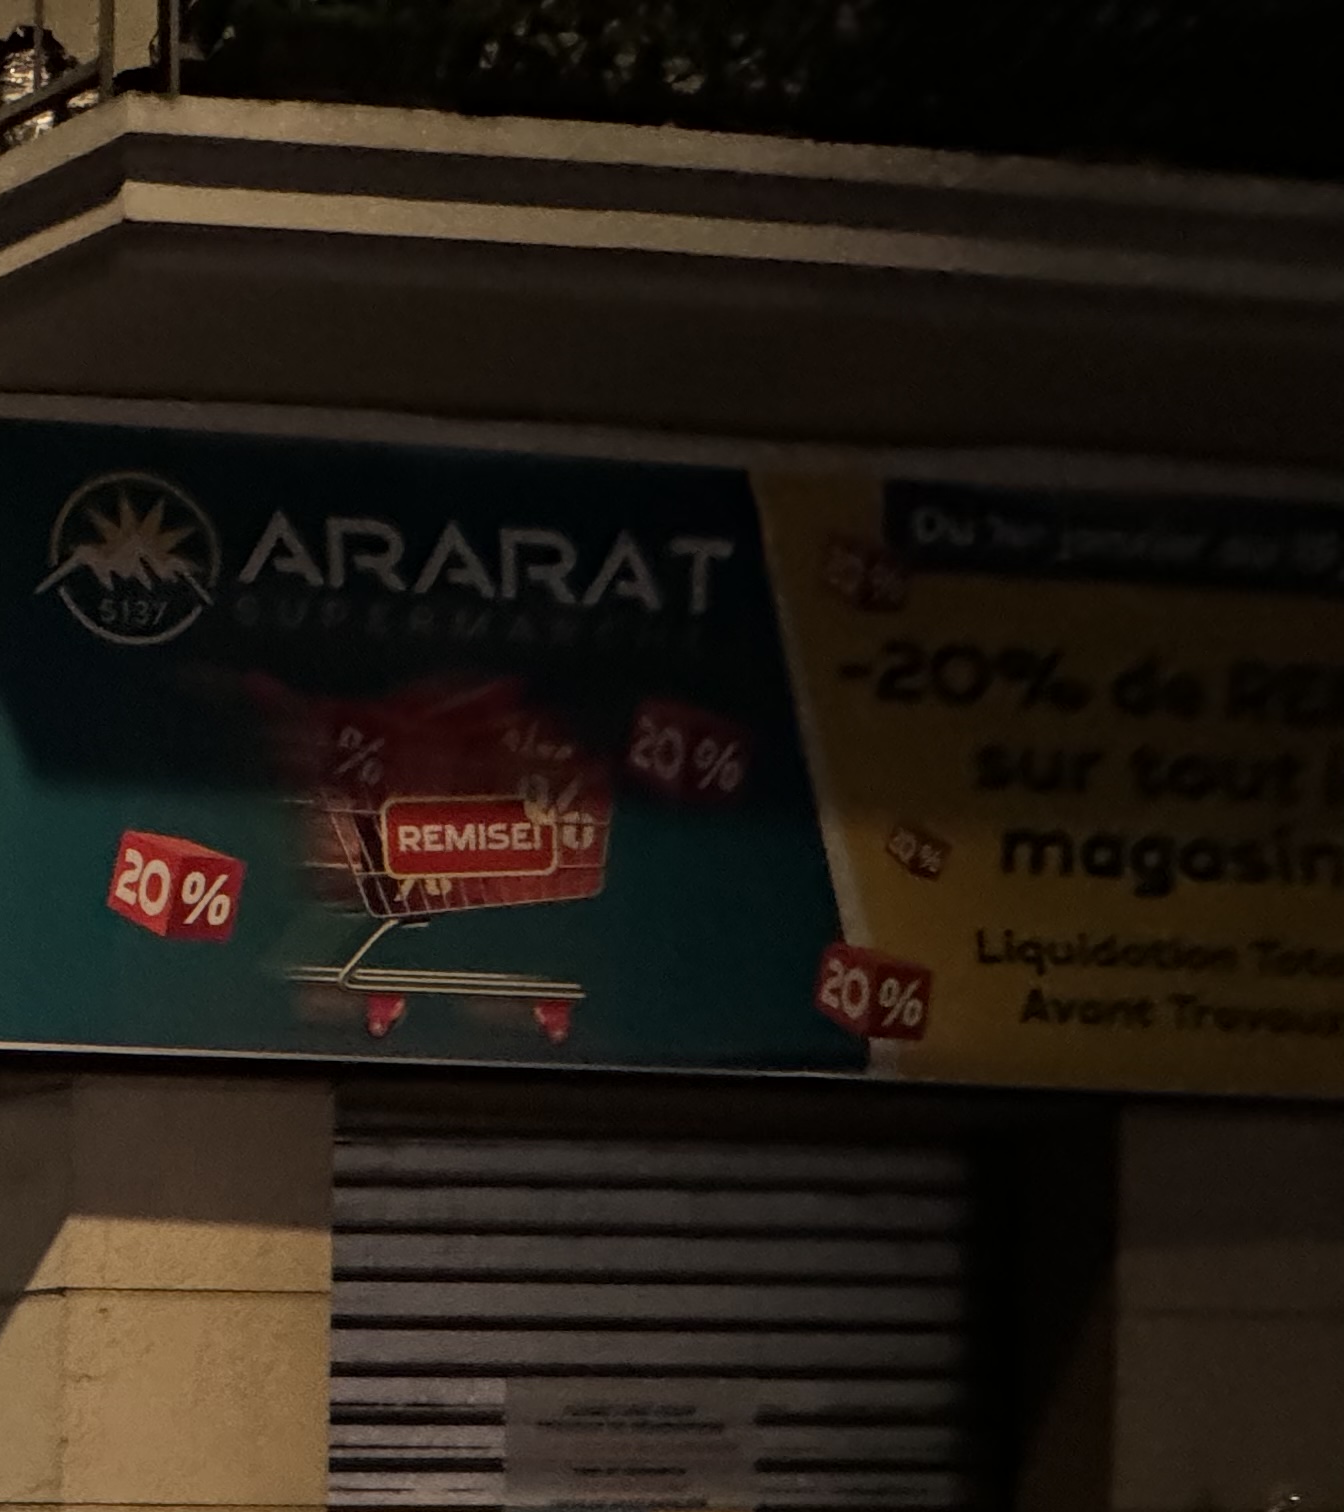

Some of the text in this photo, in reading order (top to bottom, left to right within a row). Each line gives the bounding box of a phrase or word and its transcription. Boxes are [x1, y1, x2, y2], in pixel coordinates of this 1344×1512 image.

[238, 510, 736, 615] ARARAT
[838, 639, 1094, 712] -20%
[974, 743, 1106, 795] sur
[1130, 743, 1301, 808] tout
[1001, 823, 1344, 898] magasin
[975, 928, 1239, 976] Liquidation
[1019, 988, 1154, 1029] Avant
